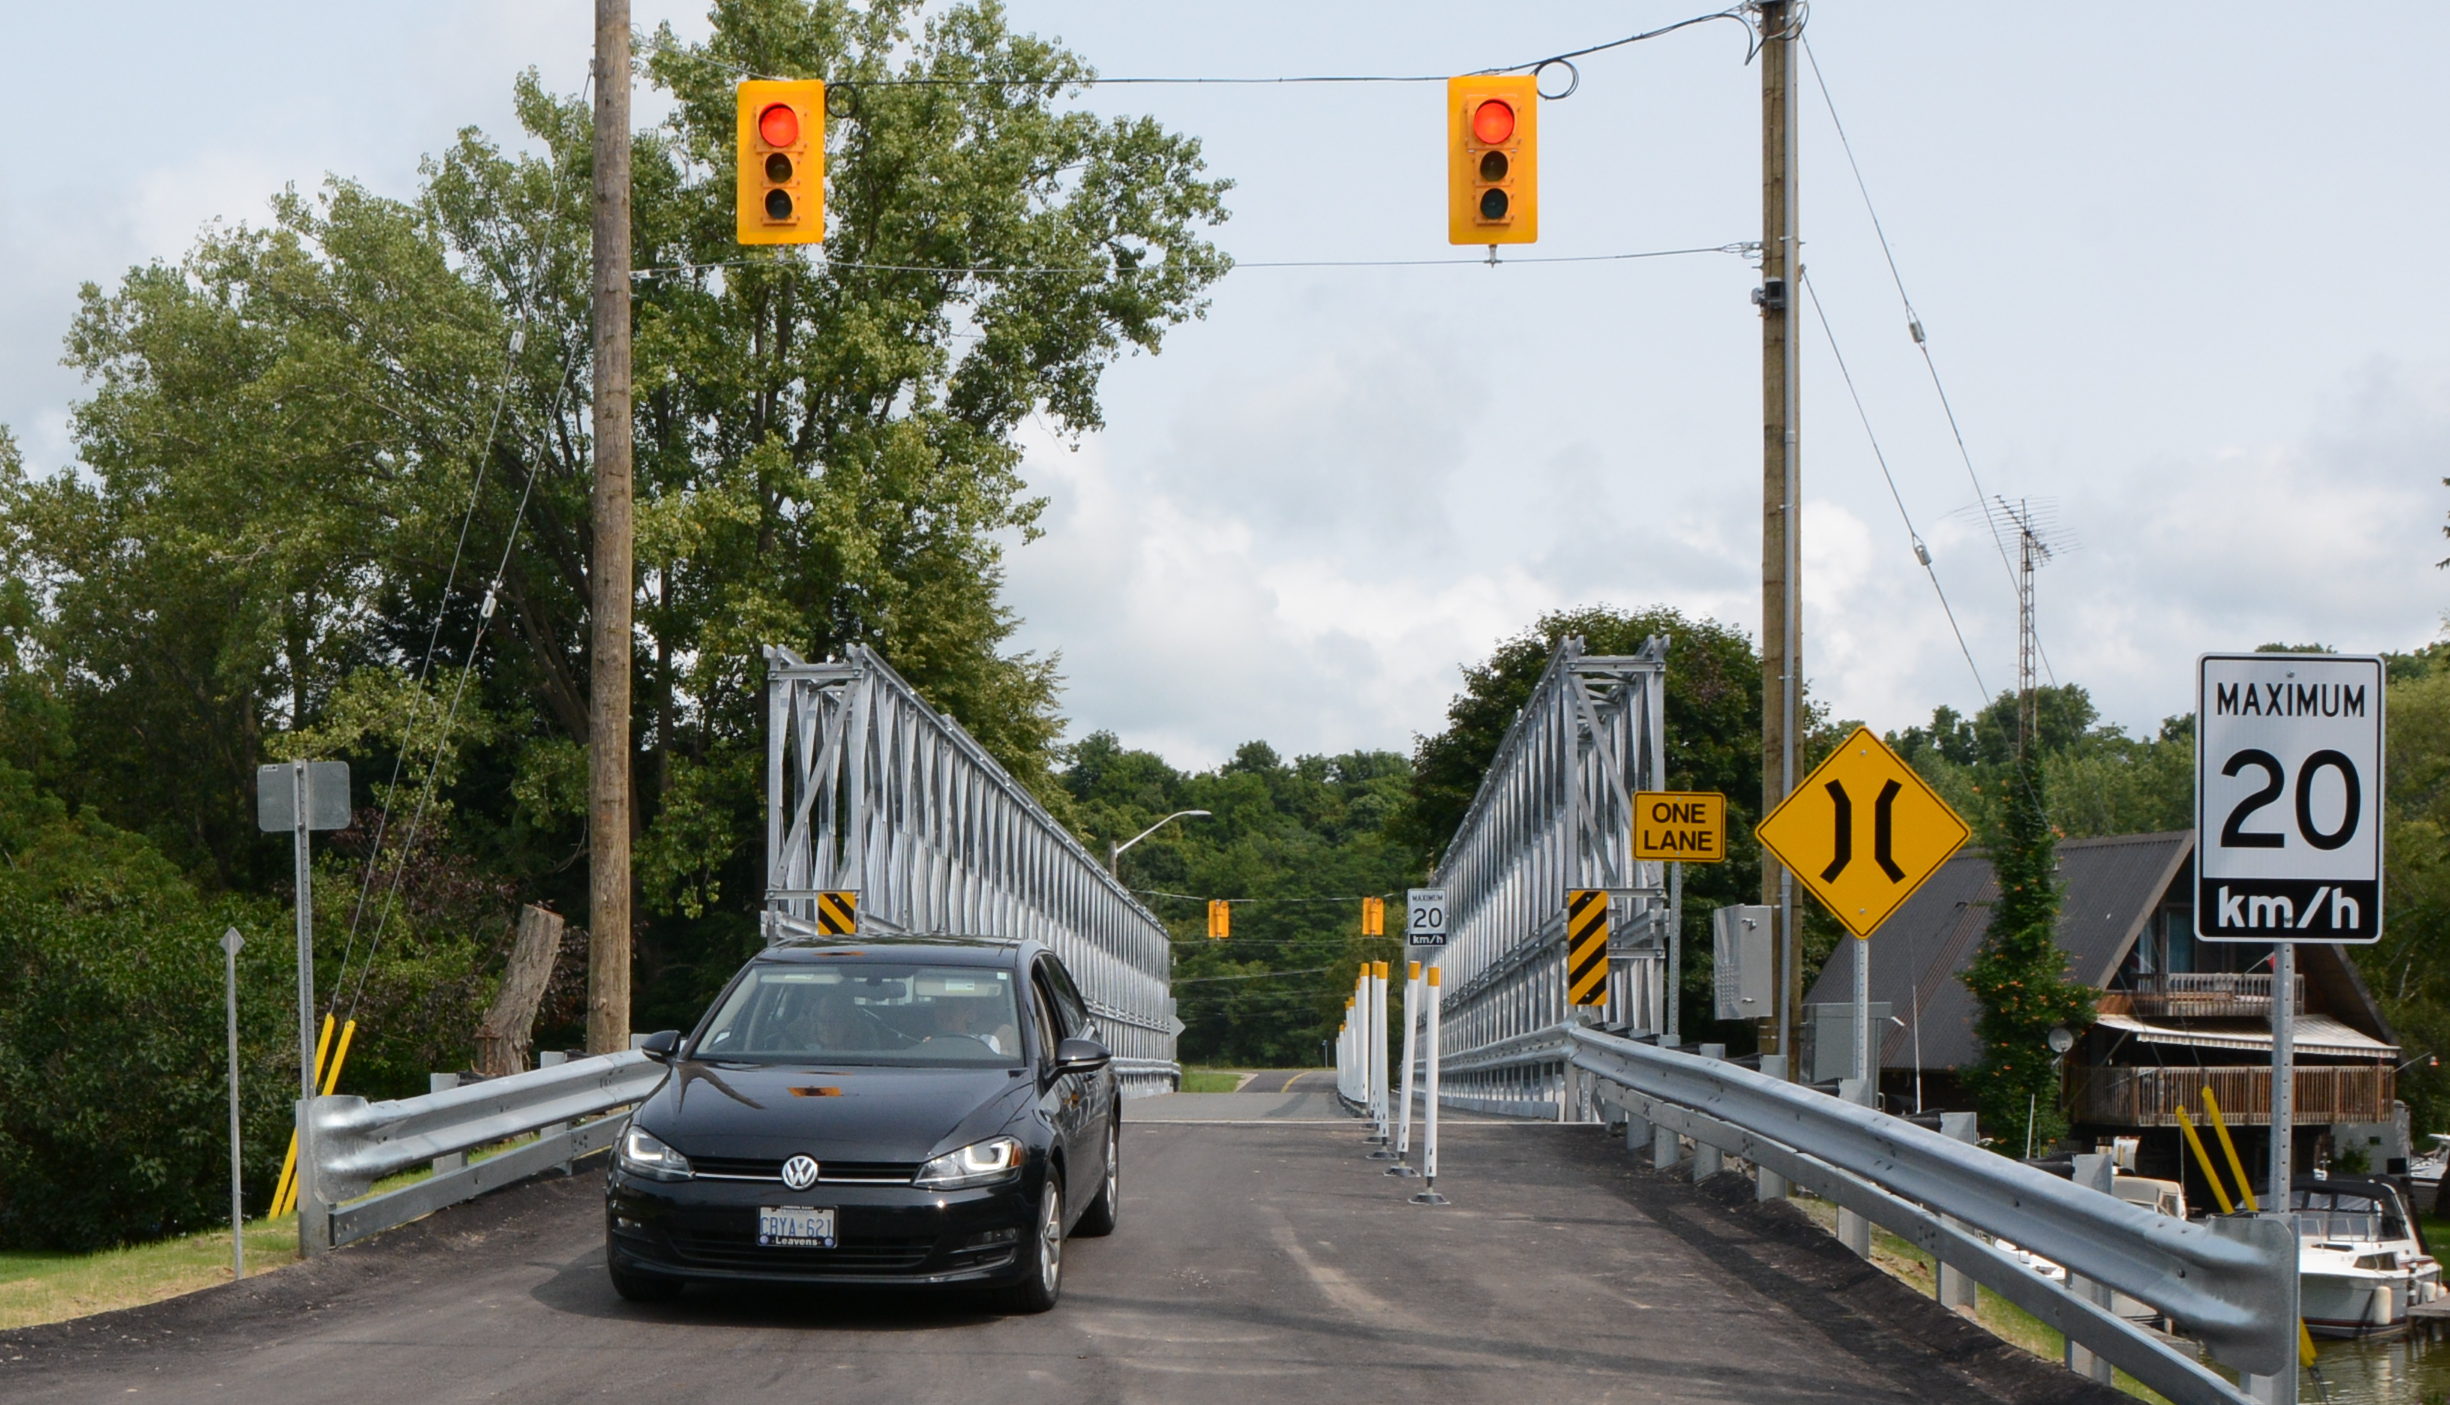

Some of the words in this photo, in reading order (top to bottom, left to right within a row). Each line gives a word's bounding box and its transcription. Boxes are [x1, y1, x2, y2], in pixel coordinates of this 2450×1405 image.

[2217, 682, 2365, 717] MAXIMUM
[2220, 748, 2361, 850] 20
[1652, 803, 1706, 824] ONE
[1644, 830, 1713, 851] LANE
[1413, 907, 1443, 928] 20
[2218, 885, 2360, 930] km/h
[1413, 935, 1443, 945] km/h
[806, 1218, 831, 1239] 621
[775, 1237, 818, 1246] Leavens
